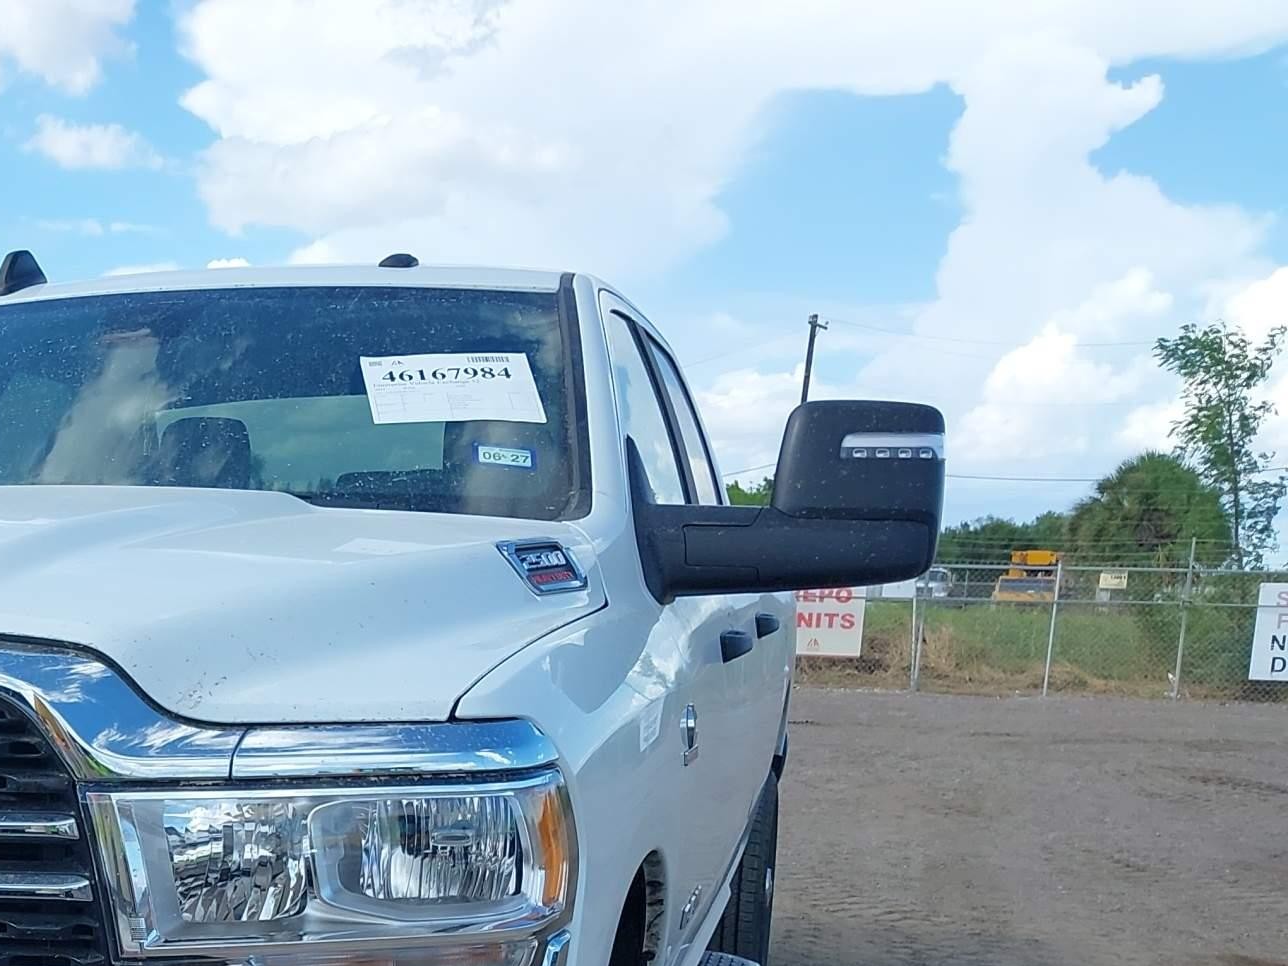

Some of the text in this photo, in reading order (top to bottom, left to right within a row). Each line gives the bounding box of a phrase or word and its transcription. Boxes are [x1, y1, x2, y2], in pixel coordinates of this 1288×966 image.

[381, 366, 512, 383] 46167984
[482, 451, 530, 464] 06 27
[519, 550, 567, 570] 2500
